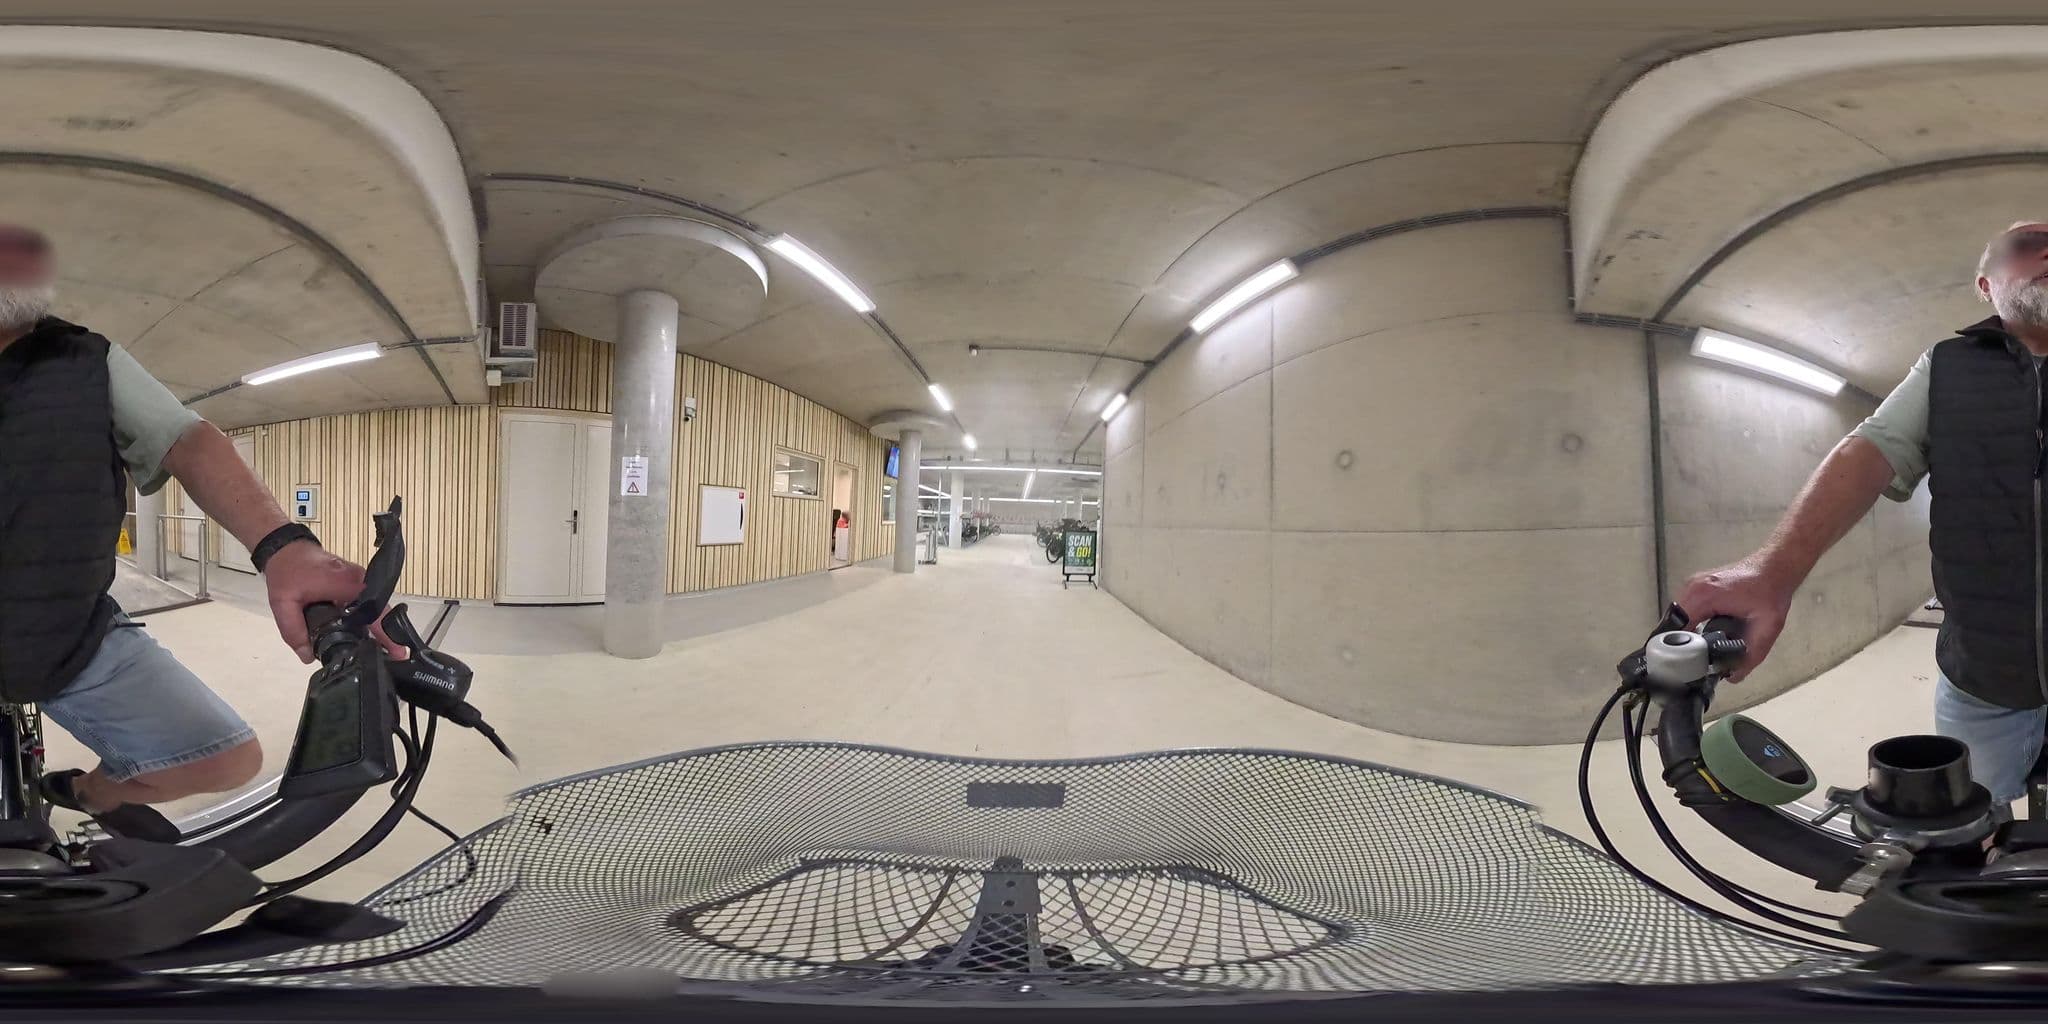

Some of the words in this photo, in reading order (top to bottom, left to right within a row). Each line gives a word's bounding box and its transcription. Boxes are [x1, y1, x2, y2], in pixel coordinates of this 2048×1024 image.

[1068, 535, 1092, 547] SCAN
[1068, 546, 1075, 558] &
[1076, 546, 1091, 558] GO!
[412, 671, 455, 691] SHIMANO
